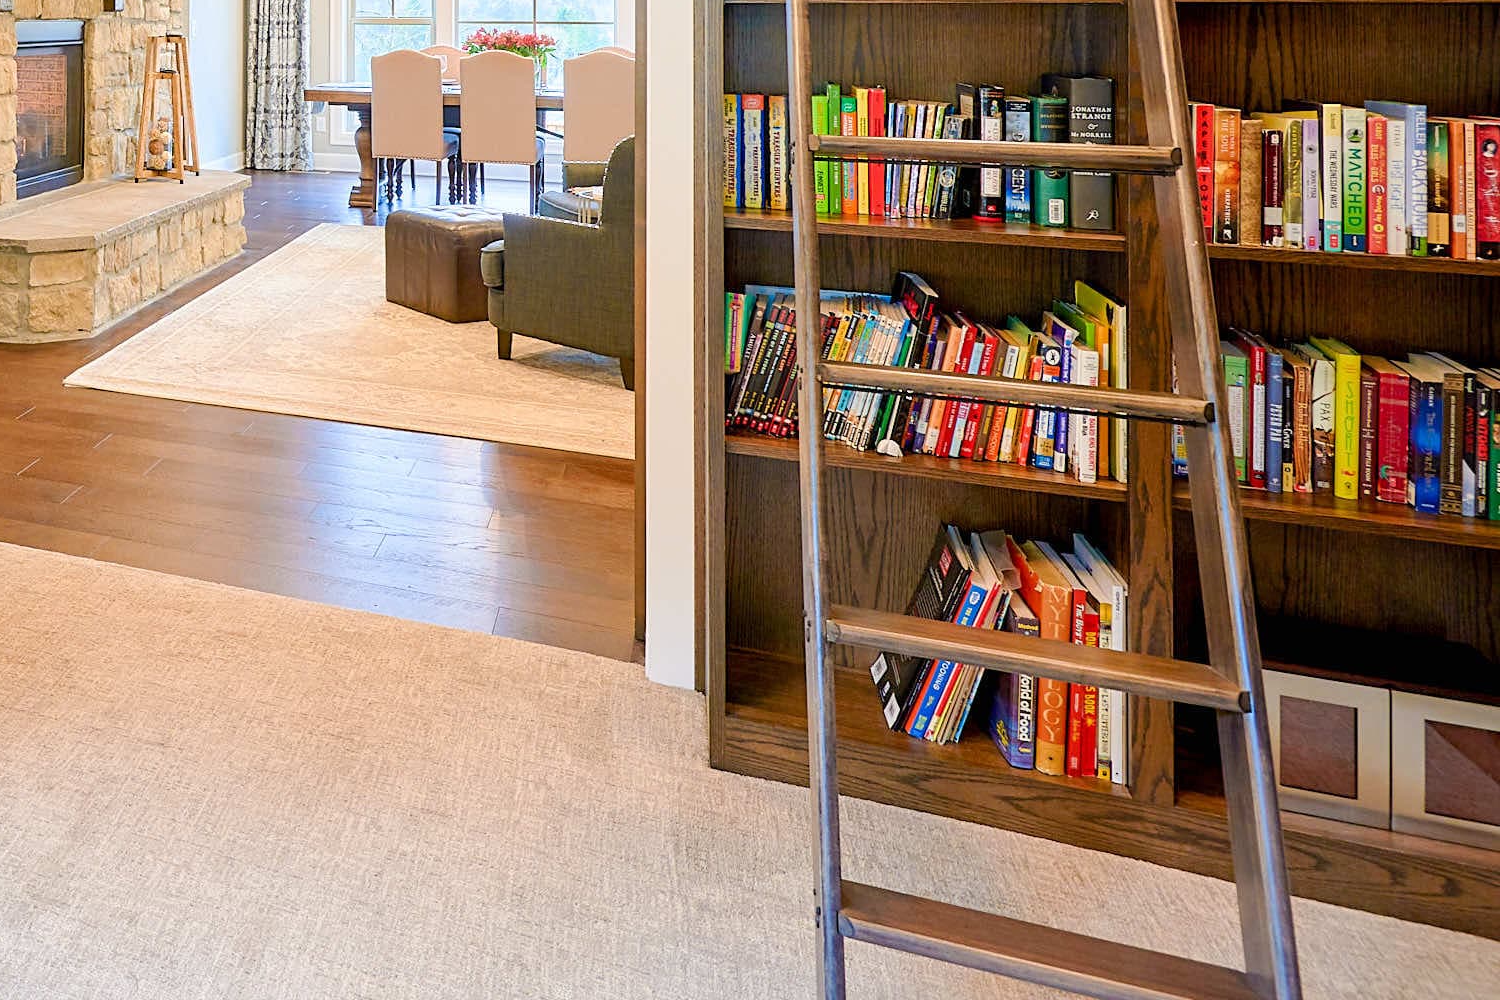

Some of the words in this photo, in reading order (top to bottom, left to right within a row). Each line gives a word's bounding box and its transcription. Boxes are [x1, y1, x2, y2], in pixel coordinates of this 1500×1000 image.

[1071, 105, 1112, 113] JONATHAN
[1071, 113, 1112, 121] STRANGE
[1415, 111, 1426, 144] KELLER
[727, 129, 735, 163] TREASURE
[772, 131, 781, 165] TREASURE
[1330, 149, 1338, 159] THE
[727, 164, 735, 195] HUNTERS
[1330, 160, 1338, 193] WEDNESDAY
[1412, 150, 1427, 189] BACK
[1348, 149, 1361, 227] MATCHED
[1330, 194, 1338, 208] WARS
[1412, 192, 1427, 236] HOME
[743, 333, 756, 359] AMULET
[1270, 403, 1282, 426] PETER
[1296, 402, 1307, 423] Ruby
[1320, 403, 1331, 421] PAX
[1088, 417, 1097, 436] BOARD
[1270, 427, 1282, 442] PAN
[1283, 428, 1293, 448] GIVER
[1298, 423, 1307, 449] Holler
[1088, 436, 1097, 449] HMS
[1088, 449, 1097, 472] BOUNTY
[1076, 603, 1085, 618] THE
[933, 660, 950, 691] TOONING
[1043, 588, 1068, 743] MYTLOGY
[1020, 701, 1032, 712] of
[1085, 694, 1096, 715] BOOK
[1020, 713, 1032, 742] Food
